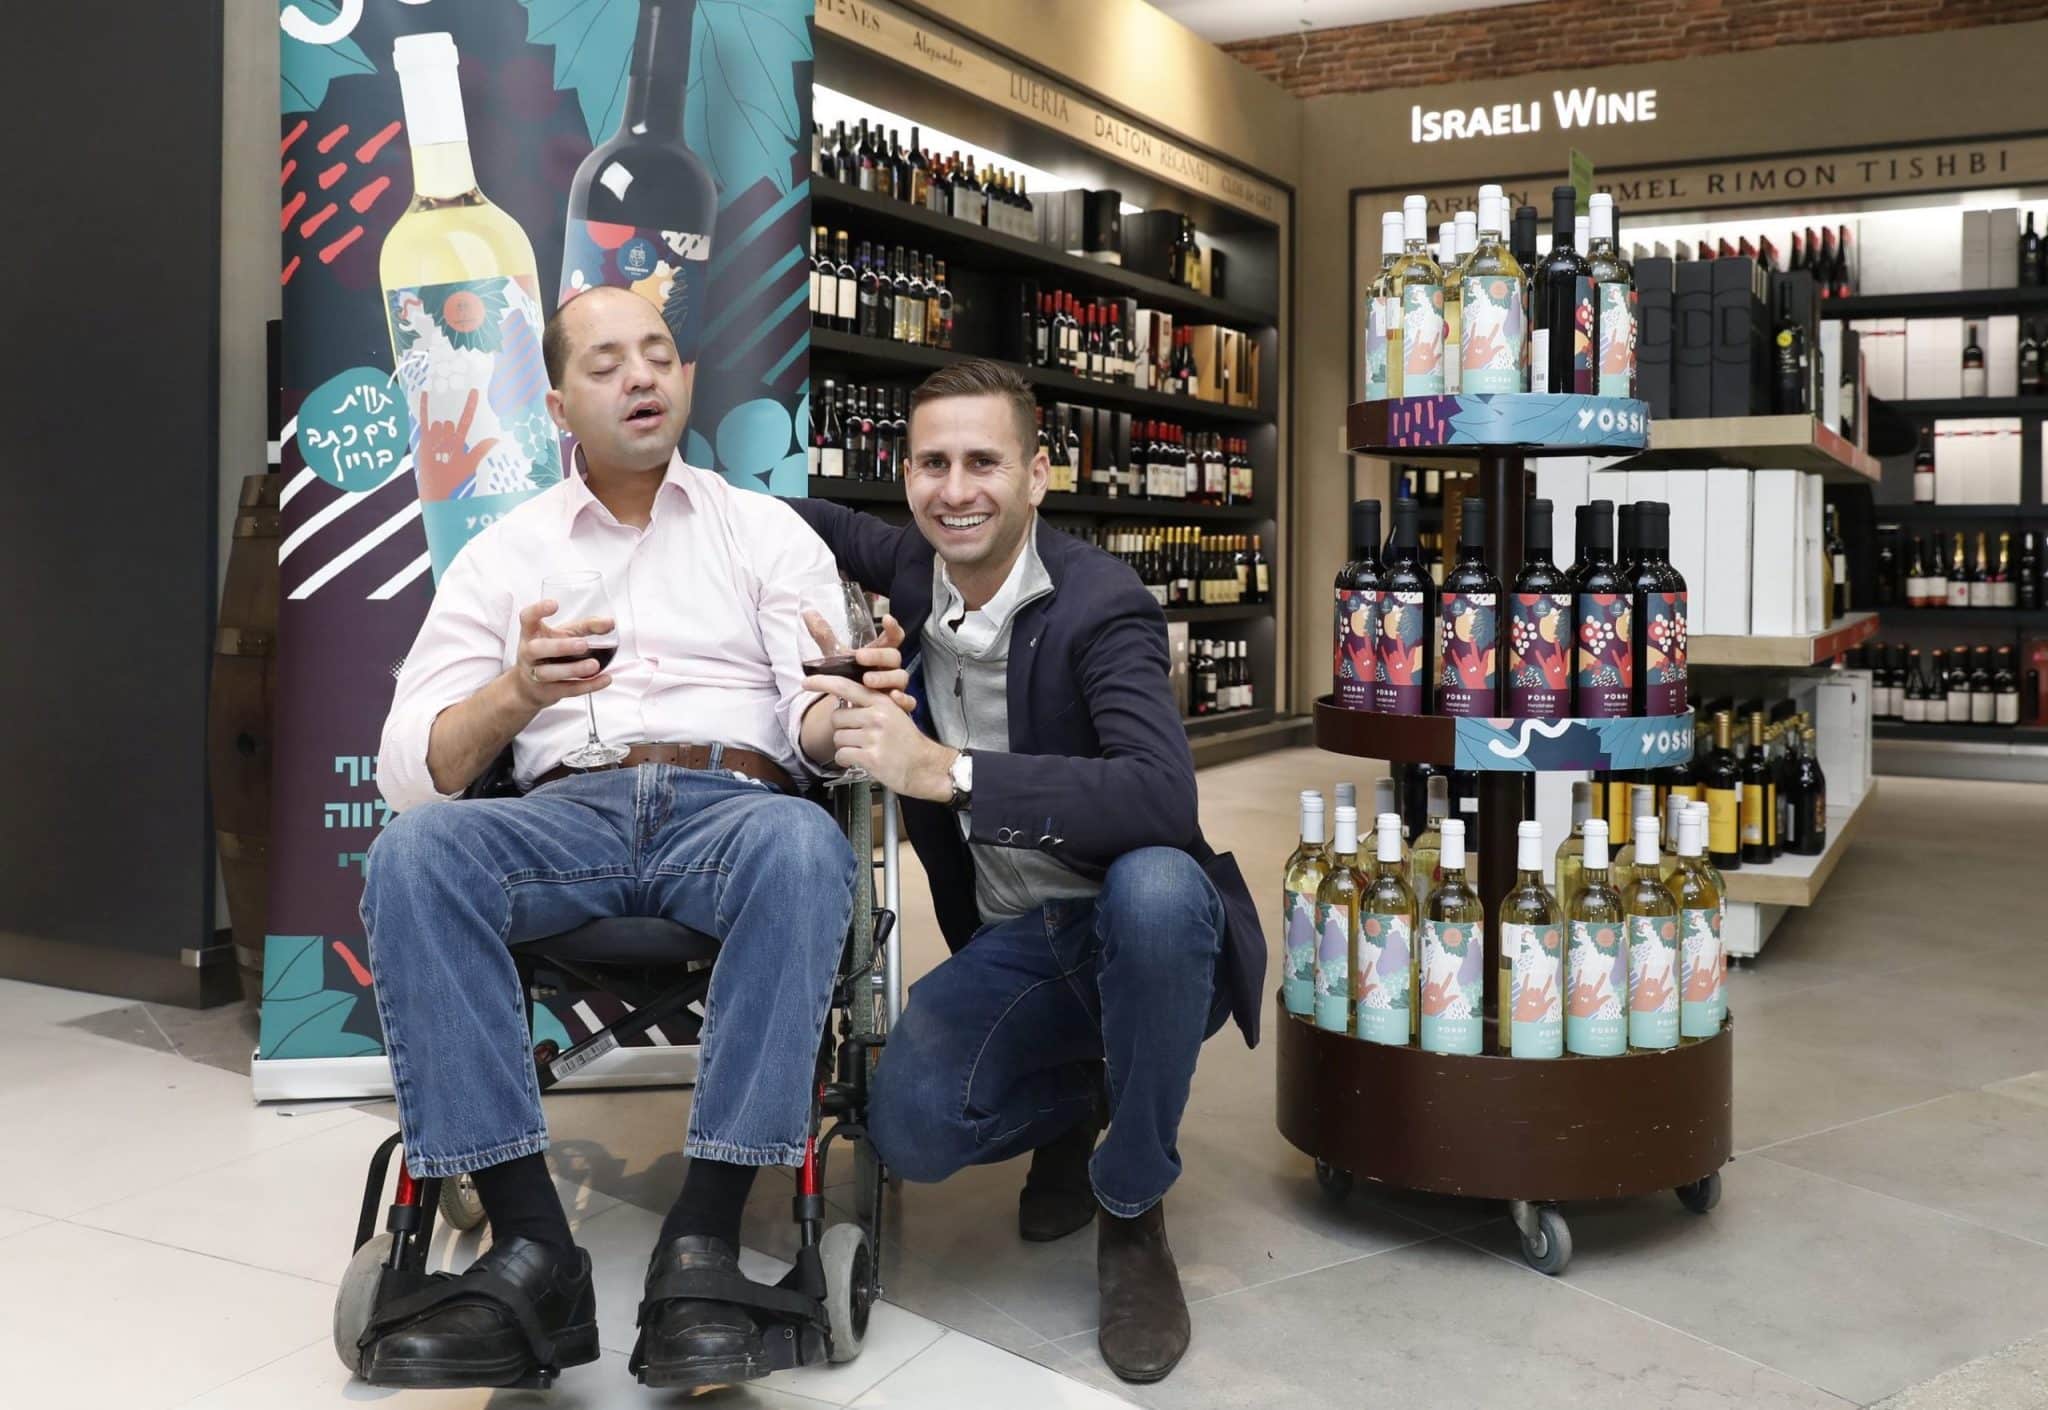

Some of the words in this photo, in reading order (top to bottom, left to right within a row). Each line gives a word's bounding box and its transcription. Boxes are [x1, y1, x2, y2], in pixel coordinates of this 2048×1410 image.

[1411, 104, 1541, 144] ISRAELI
[1552, 86, 1658, 130] WINE
[1095, 114, 1152, 157] DALTON
[1707, 164, 1837, 193] RIMON
[1857, 150, 2008, 182] TISHBI
[364, 416, 398, 446] עם
[1577, 407, 1644, 434] YOSSI
[1641, 728, 1692, 755] YOSSI
[335, 756, 379, 787] וף
